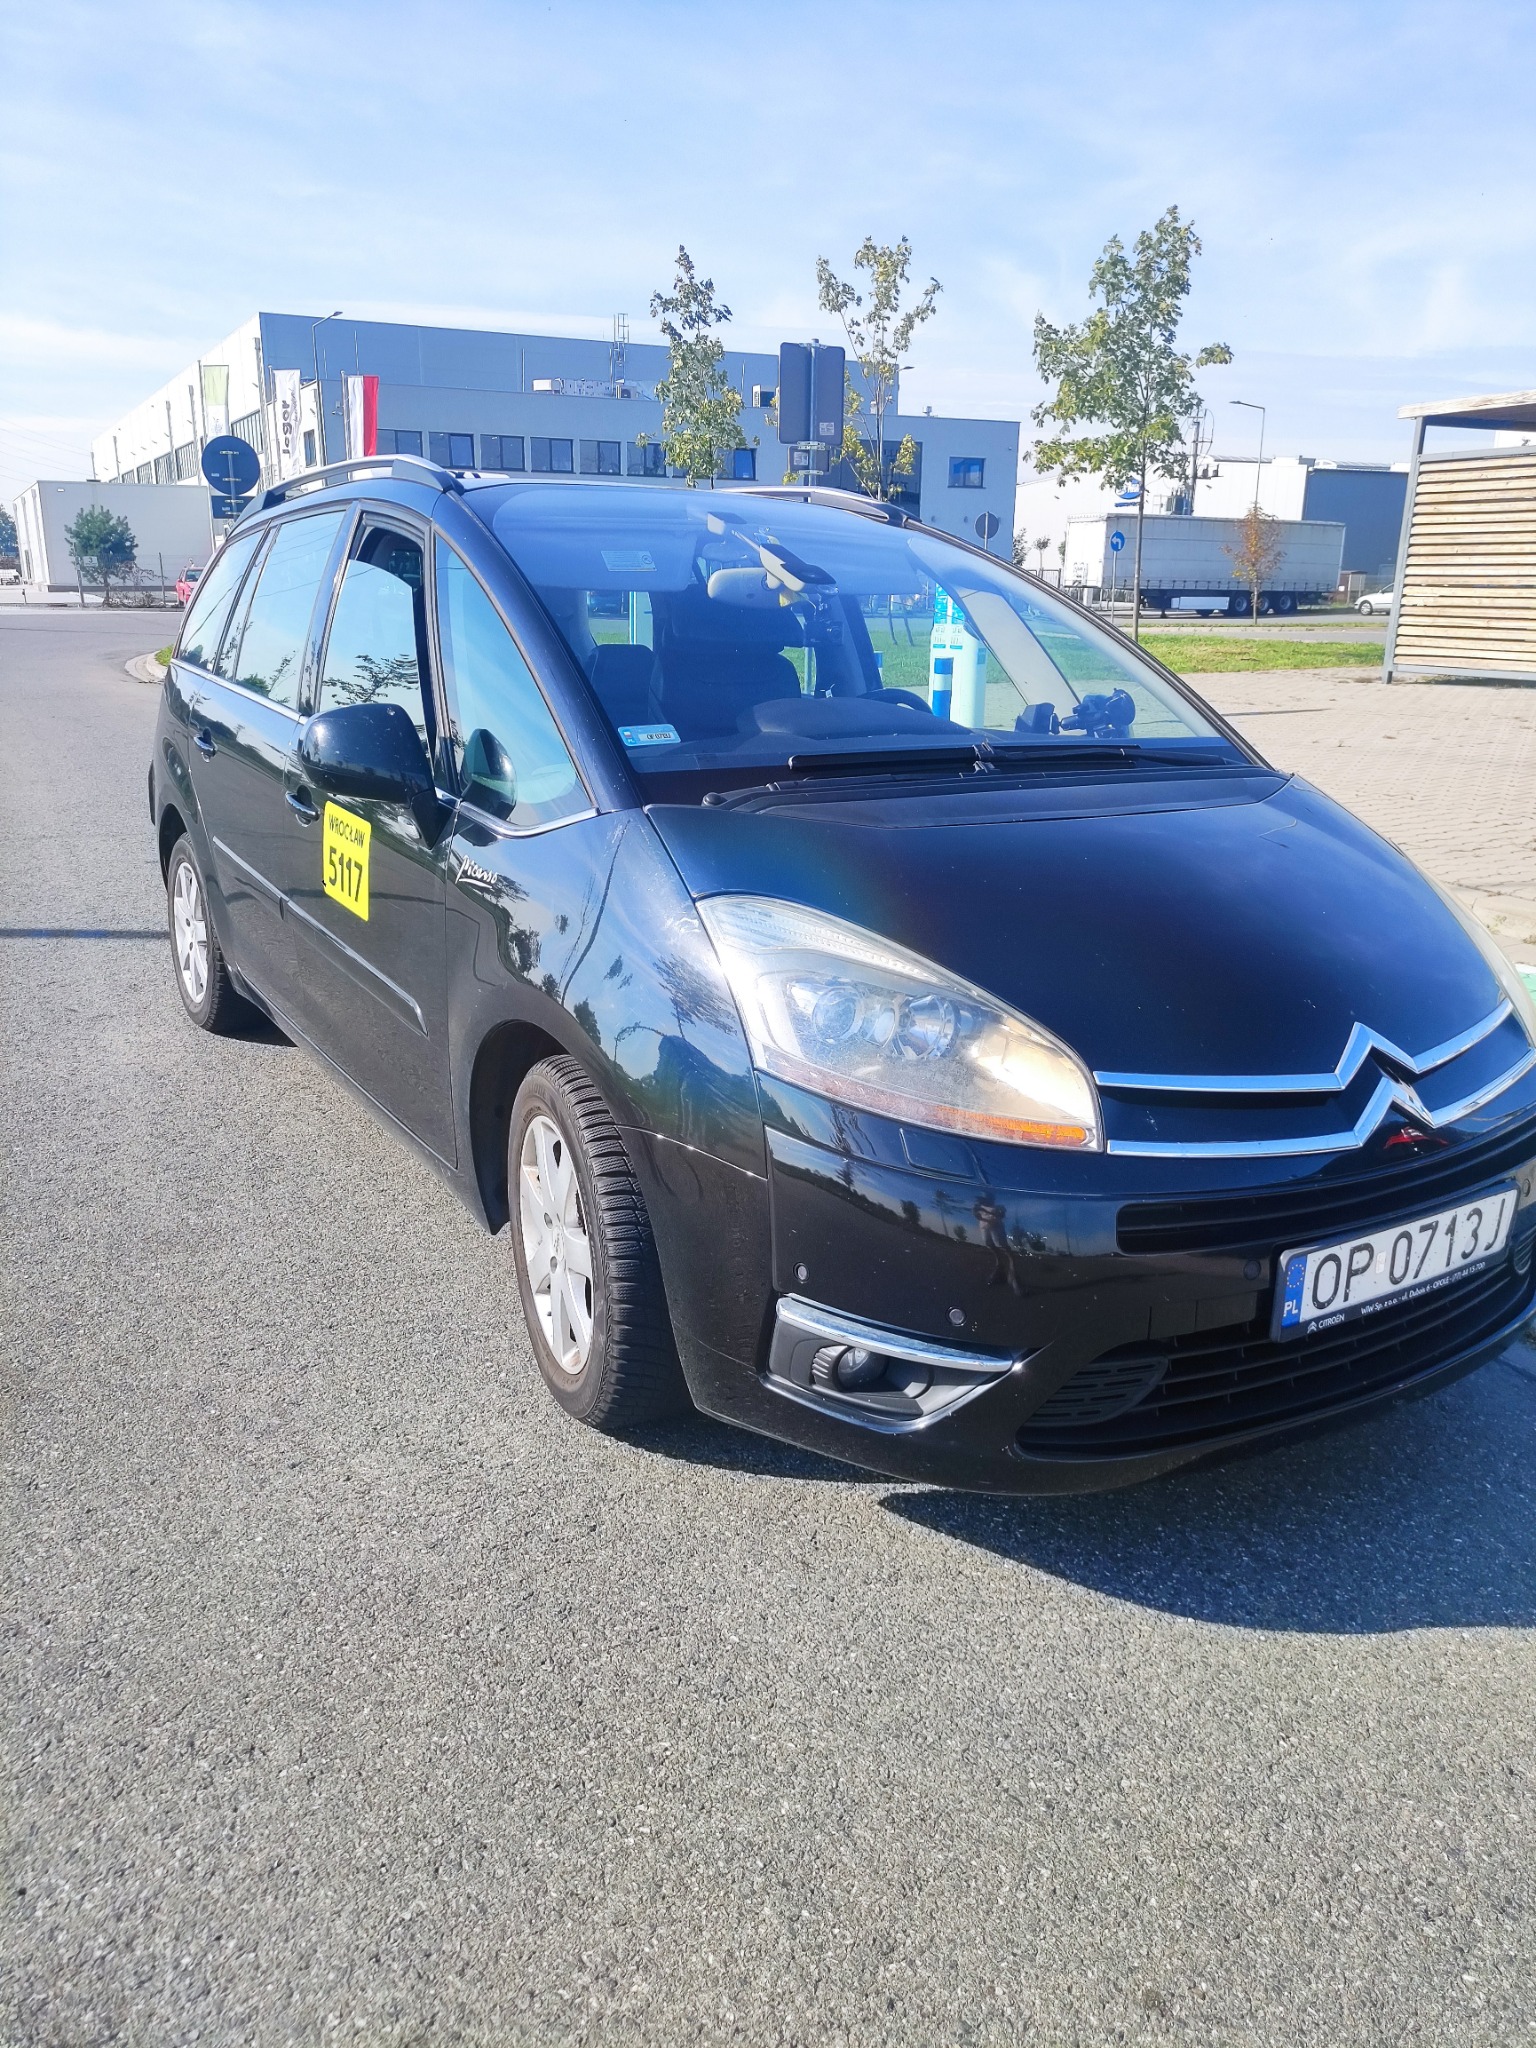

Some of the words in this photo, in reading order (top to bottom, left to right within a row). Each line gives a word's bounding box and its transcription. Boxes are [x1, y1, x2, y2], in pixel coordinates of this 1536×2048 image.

[329, 814, 365, 848] WROCŁAW
[329, 845, 363, 902] 5117
[1312, 1243, 1374, 1309] OP
[1283, 1301, 1299, 1317] PL
